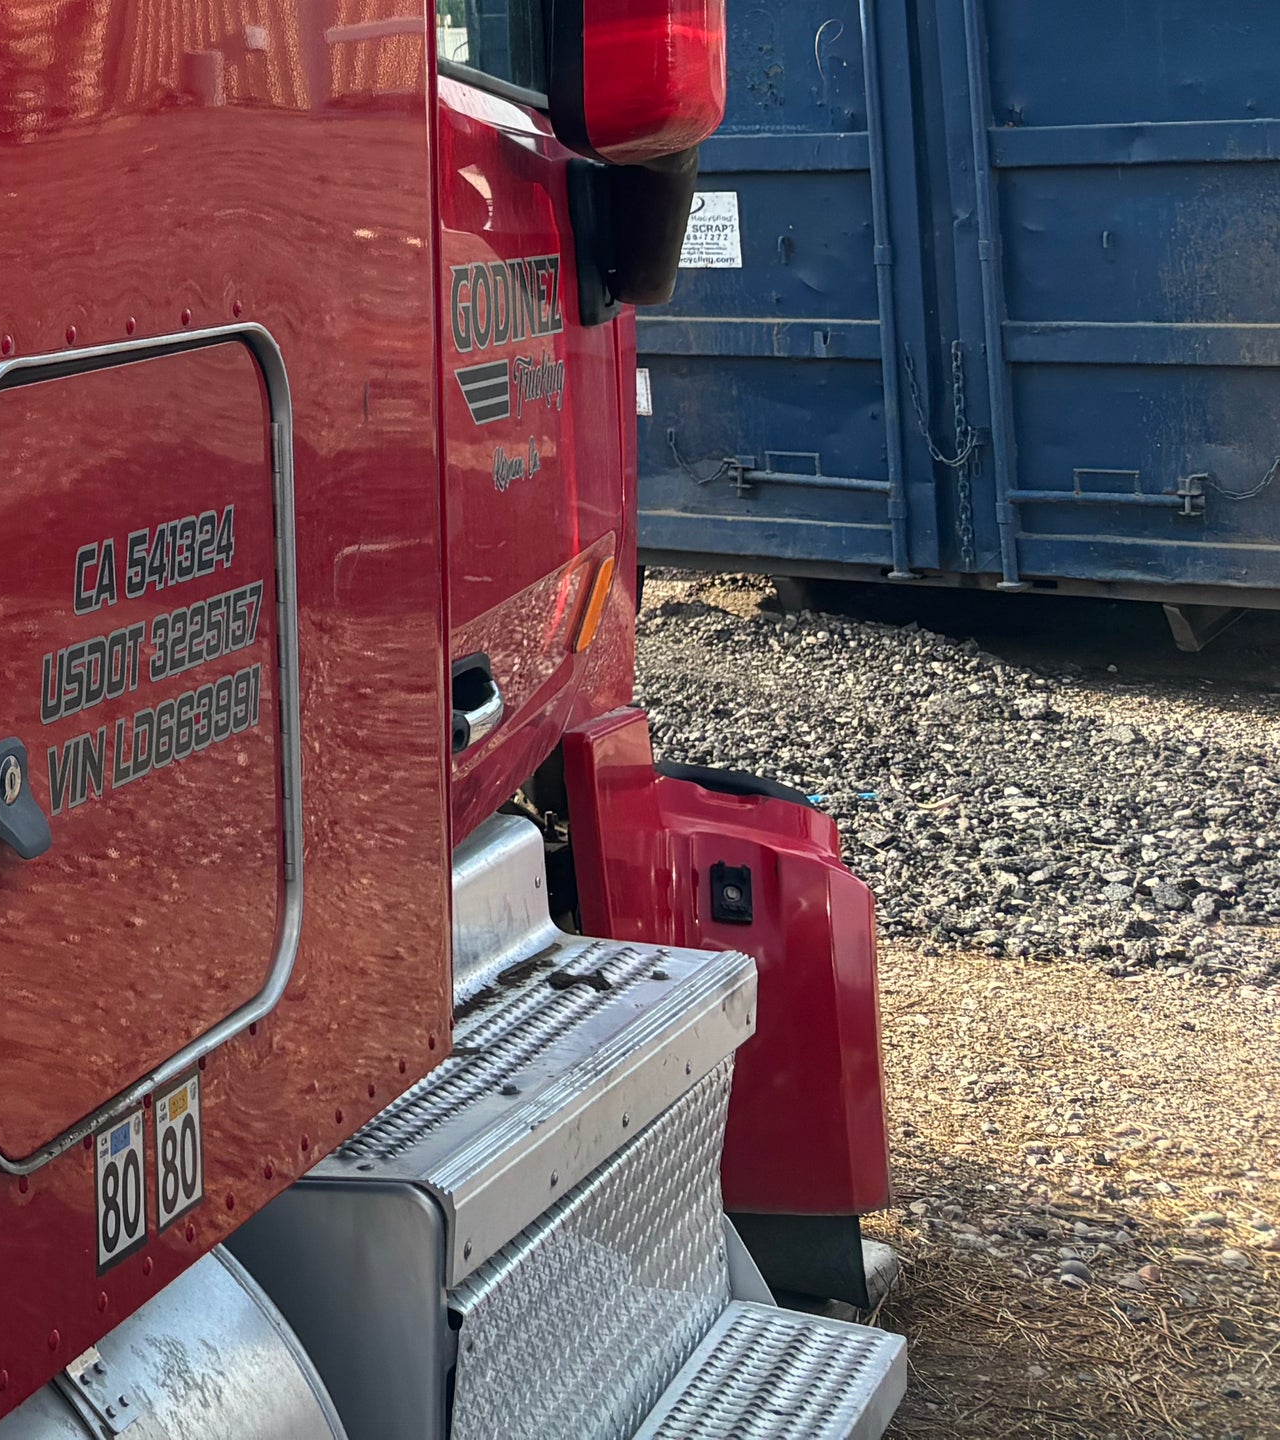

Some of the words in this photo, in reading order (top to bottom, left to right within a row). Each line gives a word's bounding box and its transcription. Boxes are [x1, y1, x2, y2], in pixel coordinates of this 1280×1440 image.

[692, 224, 735, 233] SCRAP?
[450, 253, 563, 353] GODINEZ
[512, 347, 565, 419] Trucking
[74, 537, 117, 615] CA
[126, 504, 234, 598] 541324
[40, 621, 145, 724] USDOT
[149, 579, 263, 682] 3225157
[47, 726, 106, 816] VIN
[112, 662, 261, 789] LD663991
[102, 1148, 141, 1254] 80
[162, 1112, 198, 1215] 80
